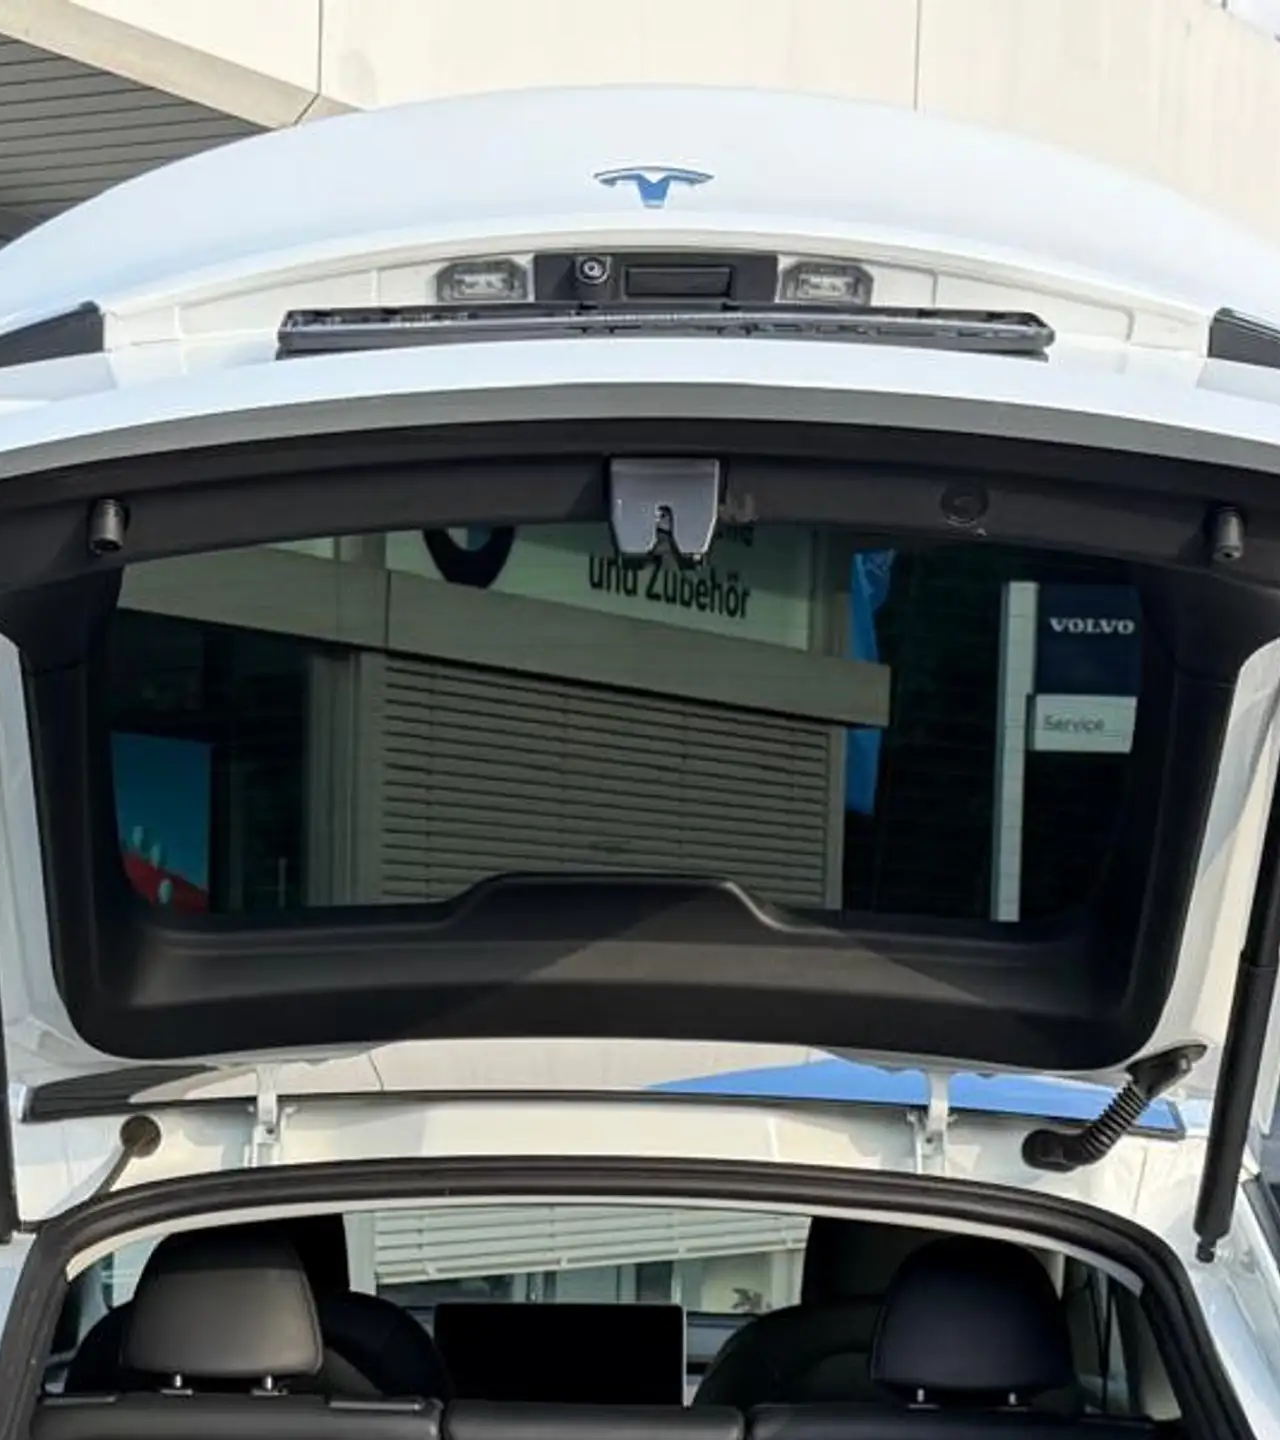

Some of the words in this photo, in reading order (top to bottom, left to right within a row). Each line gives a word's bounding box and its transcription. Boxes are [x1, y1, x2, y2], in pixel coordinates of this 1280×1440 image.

[588, 553, 639, 597] und
[645, 554, 752, 619] Zubehör
[1049, 616, 1136, 635] VOLVO
